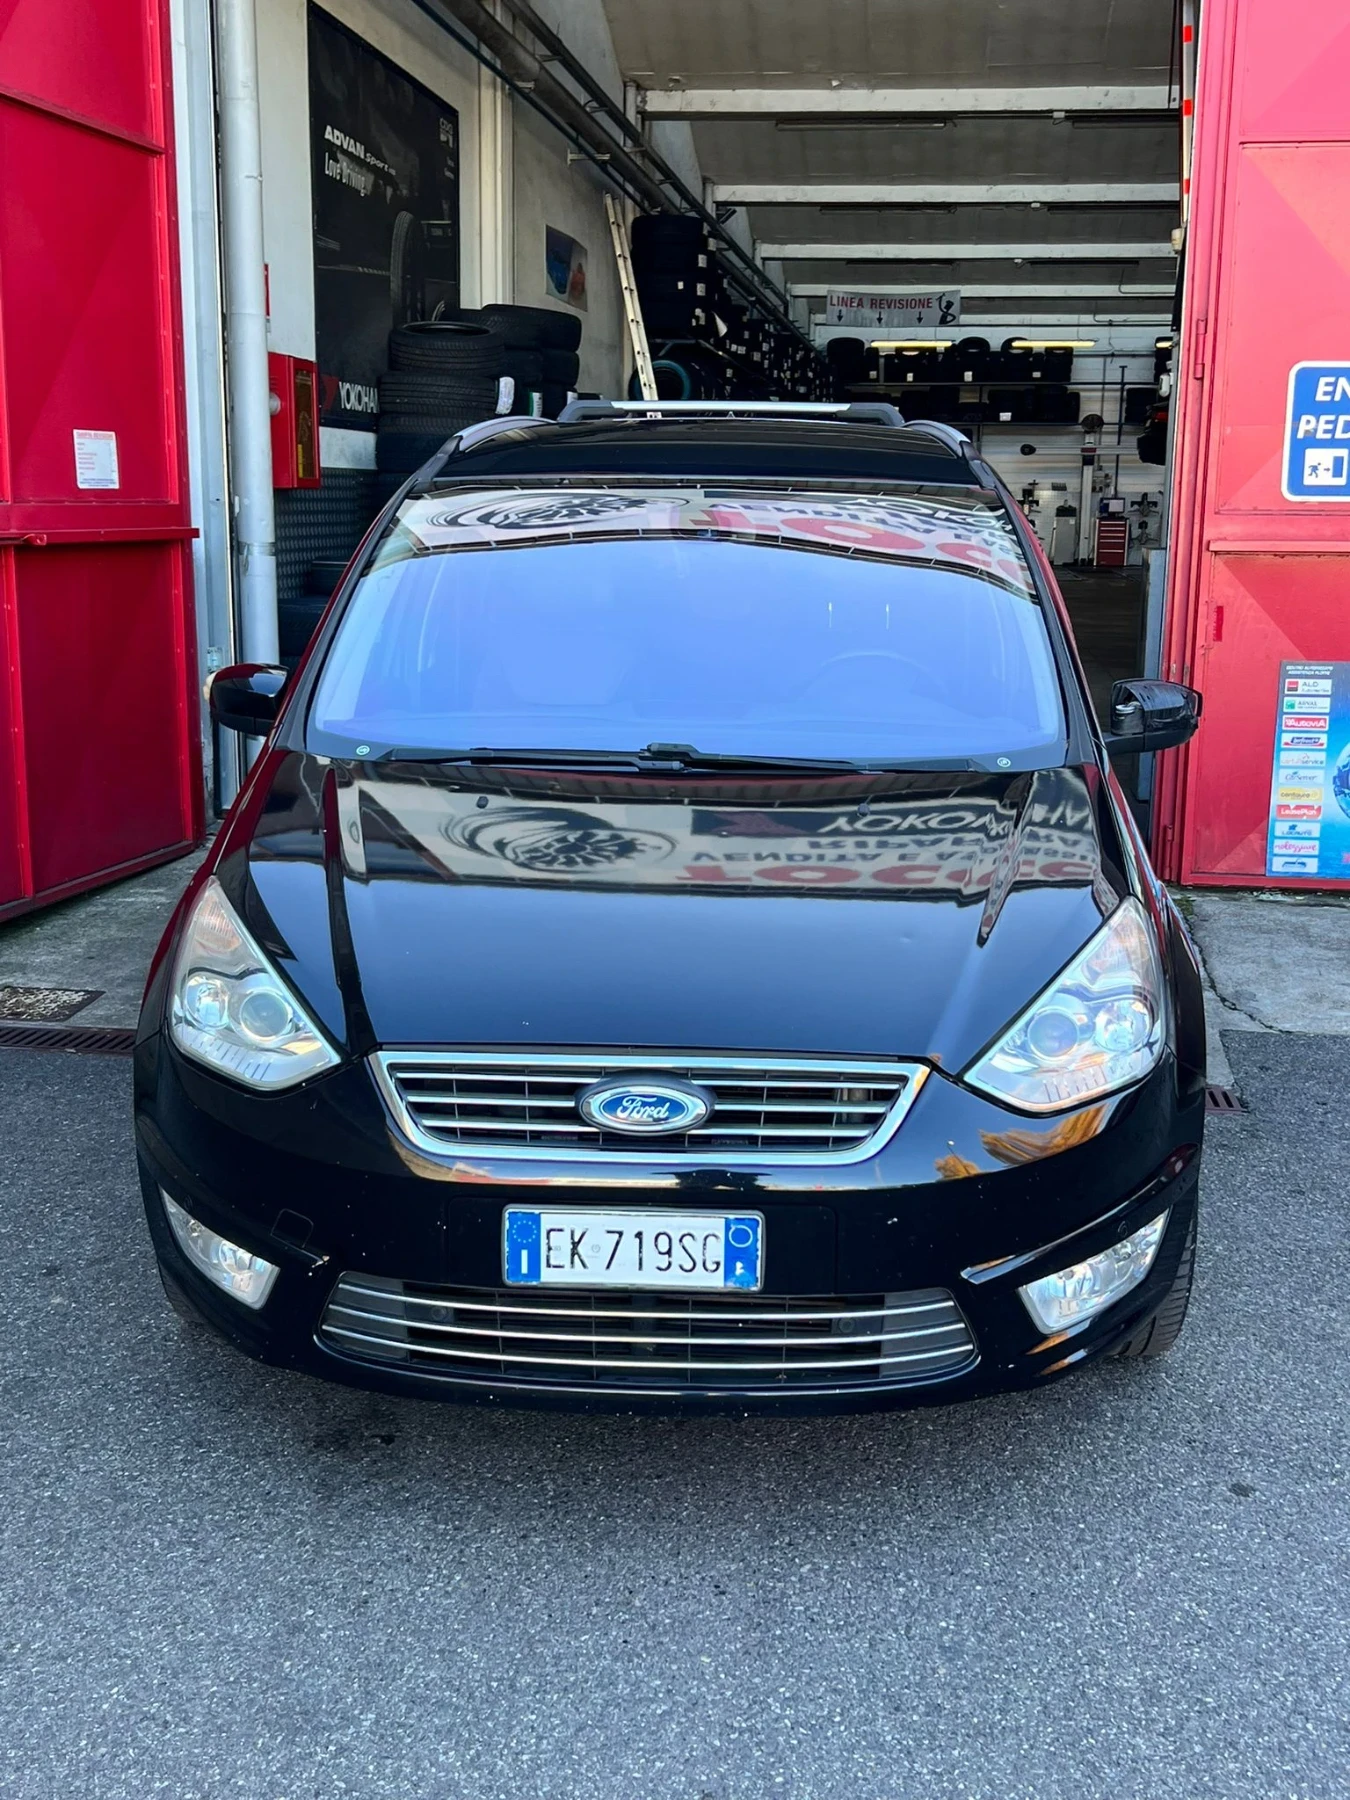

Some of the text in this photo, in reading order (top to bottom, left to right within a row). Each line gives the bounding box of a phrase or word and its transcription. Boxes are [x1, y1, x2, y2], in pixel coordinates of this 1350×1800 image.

[324, 125, 365, 159] ADVAN
[324, 152, 341, 180] Love
[829, 295, 933, 310] LINEA REVISIONE
[338, 382, 379, 413] YOKOHA
[616, 1096, 670, 1119] Ford
[545, 1227, 721, 1274] EK 719SG
